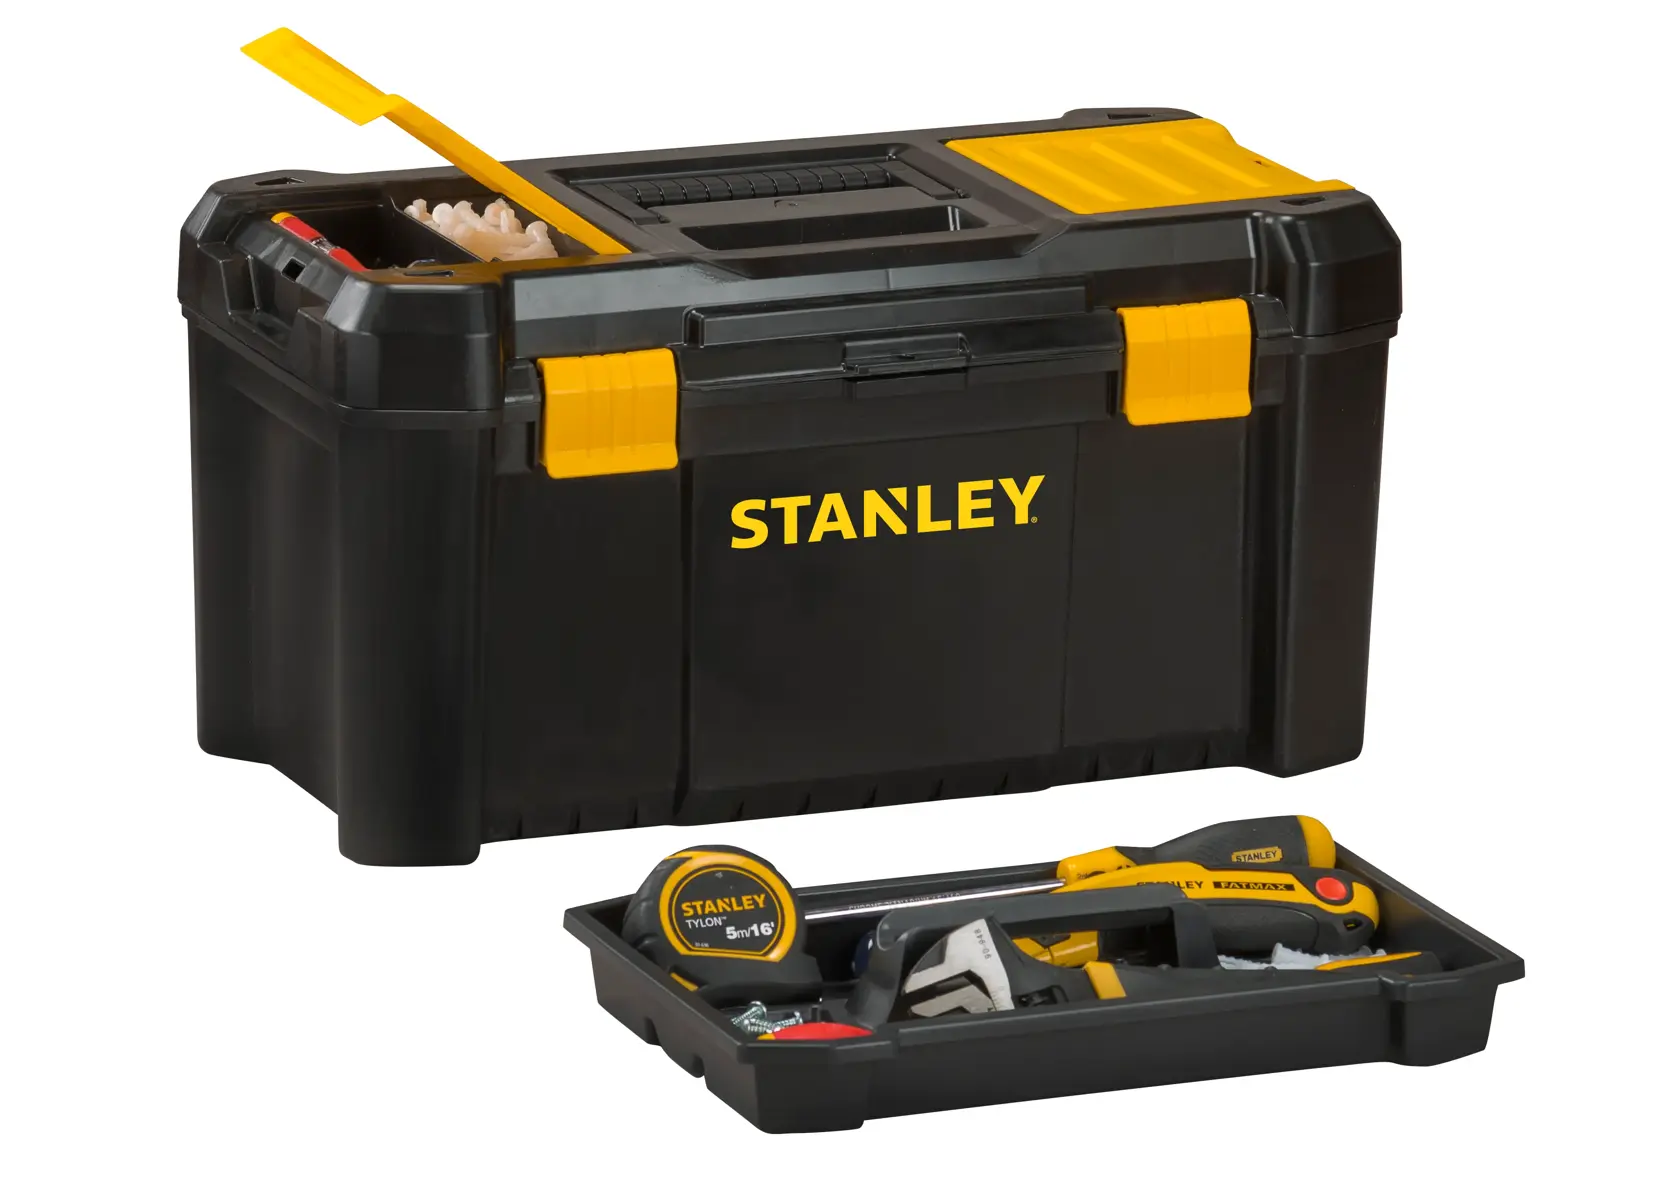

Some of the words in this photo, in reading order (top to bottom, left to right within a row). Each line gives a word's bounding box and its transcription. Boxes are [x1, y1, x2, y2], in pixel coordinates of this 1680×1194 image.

[1236, 849, 1277, 863] STANLEY
[1220, 881, 1287, 891] FATMAX
[681, 893, 766, 917] STANLEY
